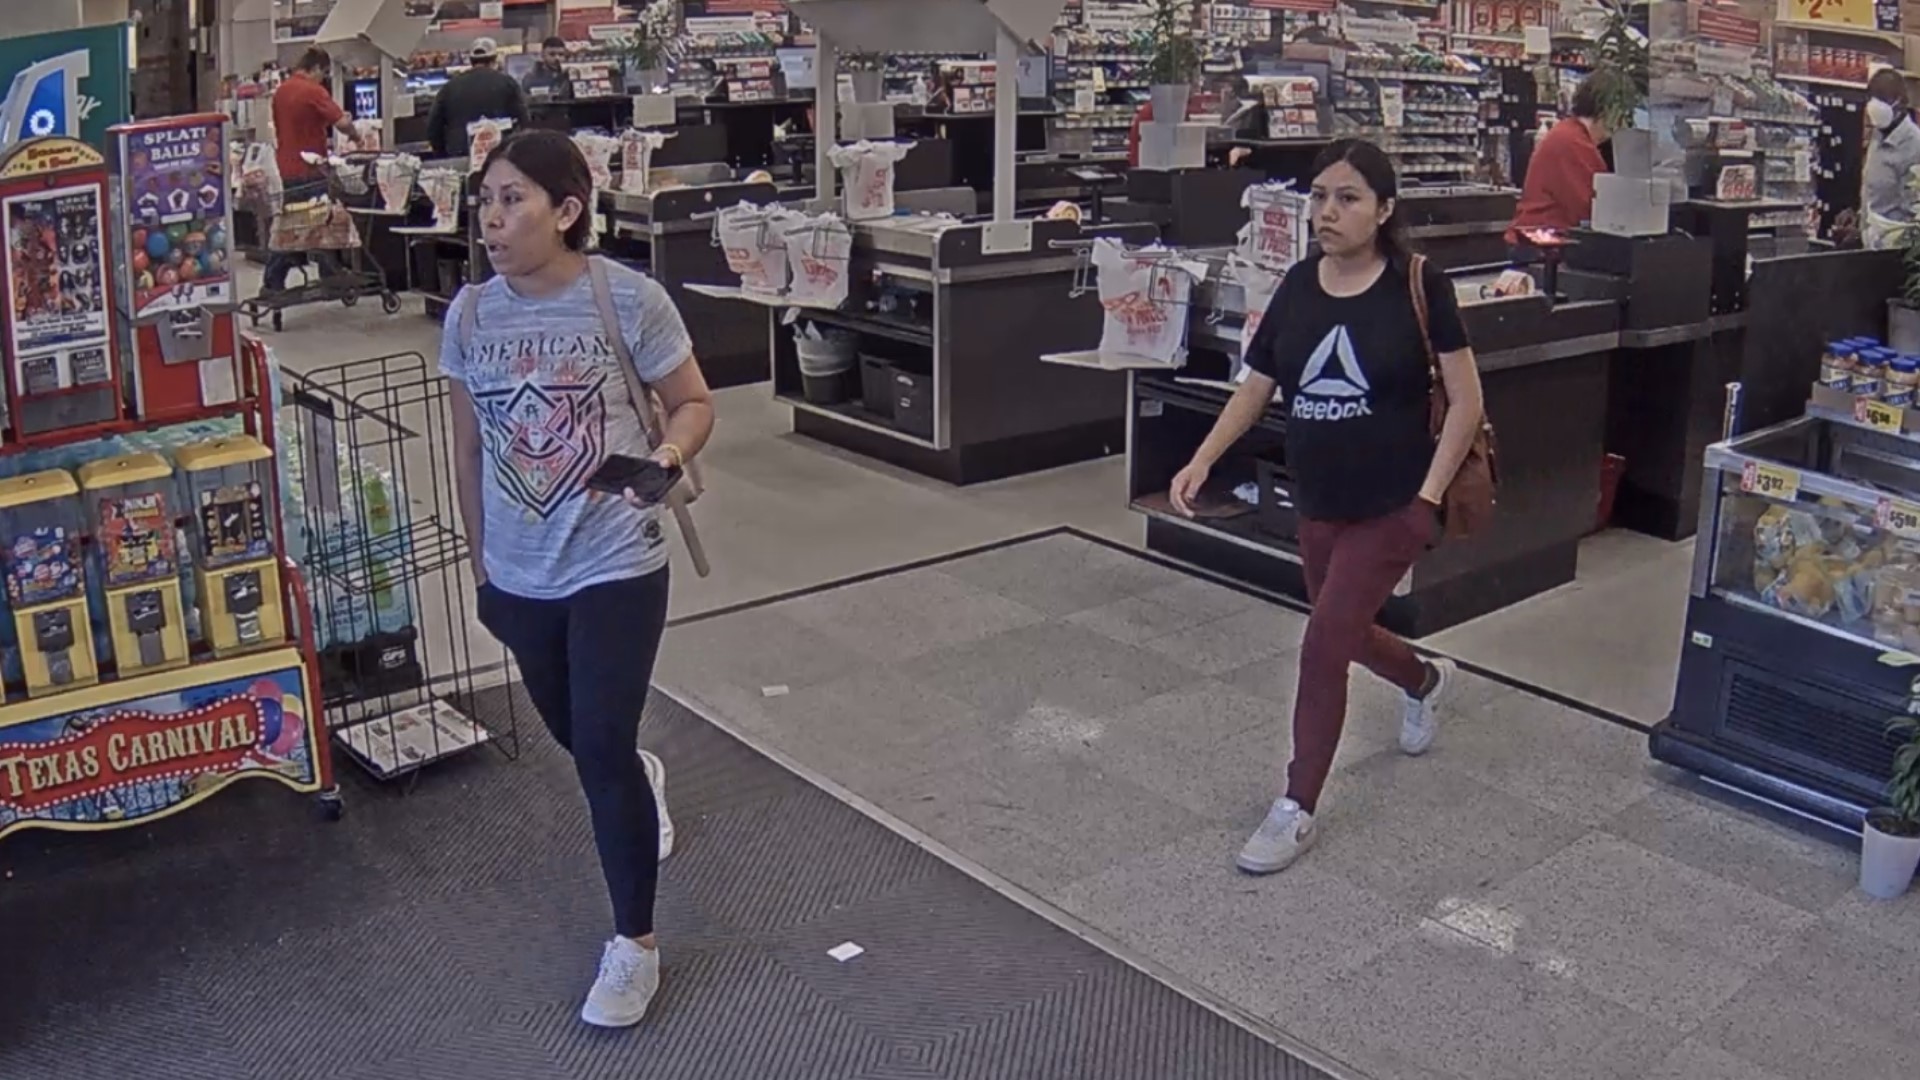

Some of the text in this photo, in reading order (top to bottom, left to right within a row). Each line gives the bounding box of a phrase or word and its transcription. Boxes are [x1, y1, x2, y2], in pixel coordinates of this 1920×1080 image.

[144, 127, 207, 145] SPLAT!
[151, 142, 200, 161] BALLS
[461, 335, 609, 363] AMERICAN
[1291, 395, 1373, 420] Reebok
[0, 713, 256, 797] TEXAS CARNIVAL
